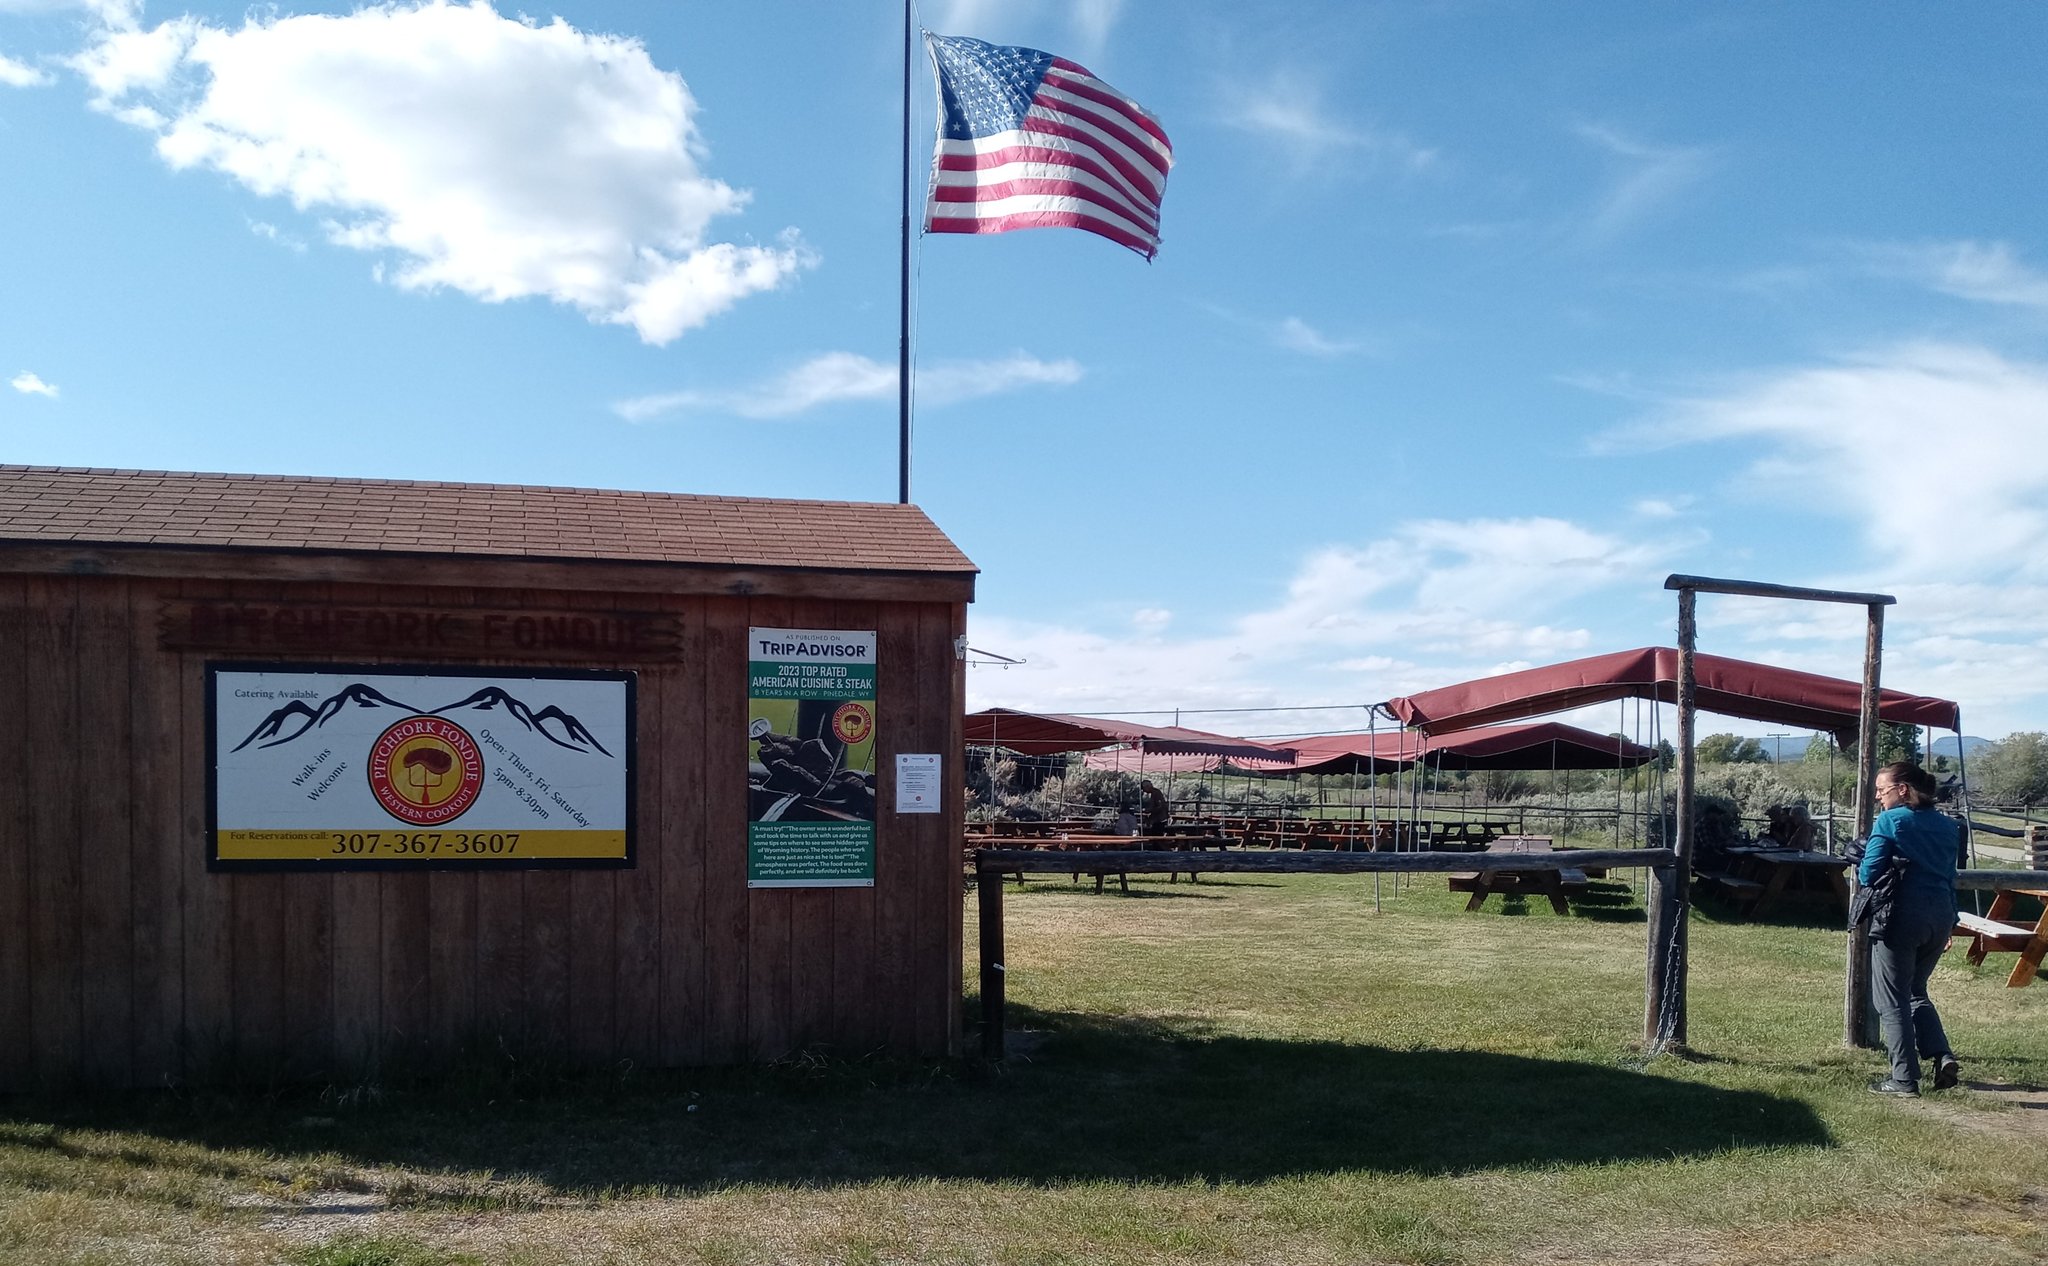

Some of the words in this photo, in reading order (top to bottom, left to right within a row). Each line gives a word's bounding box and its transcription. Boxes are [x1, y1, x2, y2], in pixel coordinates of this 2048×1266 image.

[752, 676, 798, 688] AMERICAN
[801, 677, 836, 689] CUISINE
[837, 678, 844, 689] &
[845, 678, 872, 689] STEAK
[778, 665, 800, 676] 2023
[801, 666, 818, 676] TOP
[820, 666, 847, 677] RATED
[234, 689, 275, 700] Catering
[277, 690, 319, 699] Available
[291, 748, 331, 787] Walk-ins
[374, 721, 436, 779] PITCHFORK
[439, 725, 478, 781] FONDUE
[307, 761, 348, 801] Welcome
[480, 729, 508, 755] Open:
[508, 752, 534, 781] Thurs,
[535, 777, 551, 795] Fri,
[551, 791, 590, 828] Saturday
[493, 767, 549, 820] 5pm-8:30pm
[380, 786, 423, 818] WESTERN
[426, 787, 472, 819] COOKOUT
[230, 831, 245, 840] For
[249, 831, 308, 840] Reservations
[310, 831, 329, 840] call:
[332, 833, 520, 854] 307-367-3607
